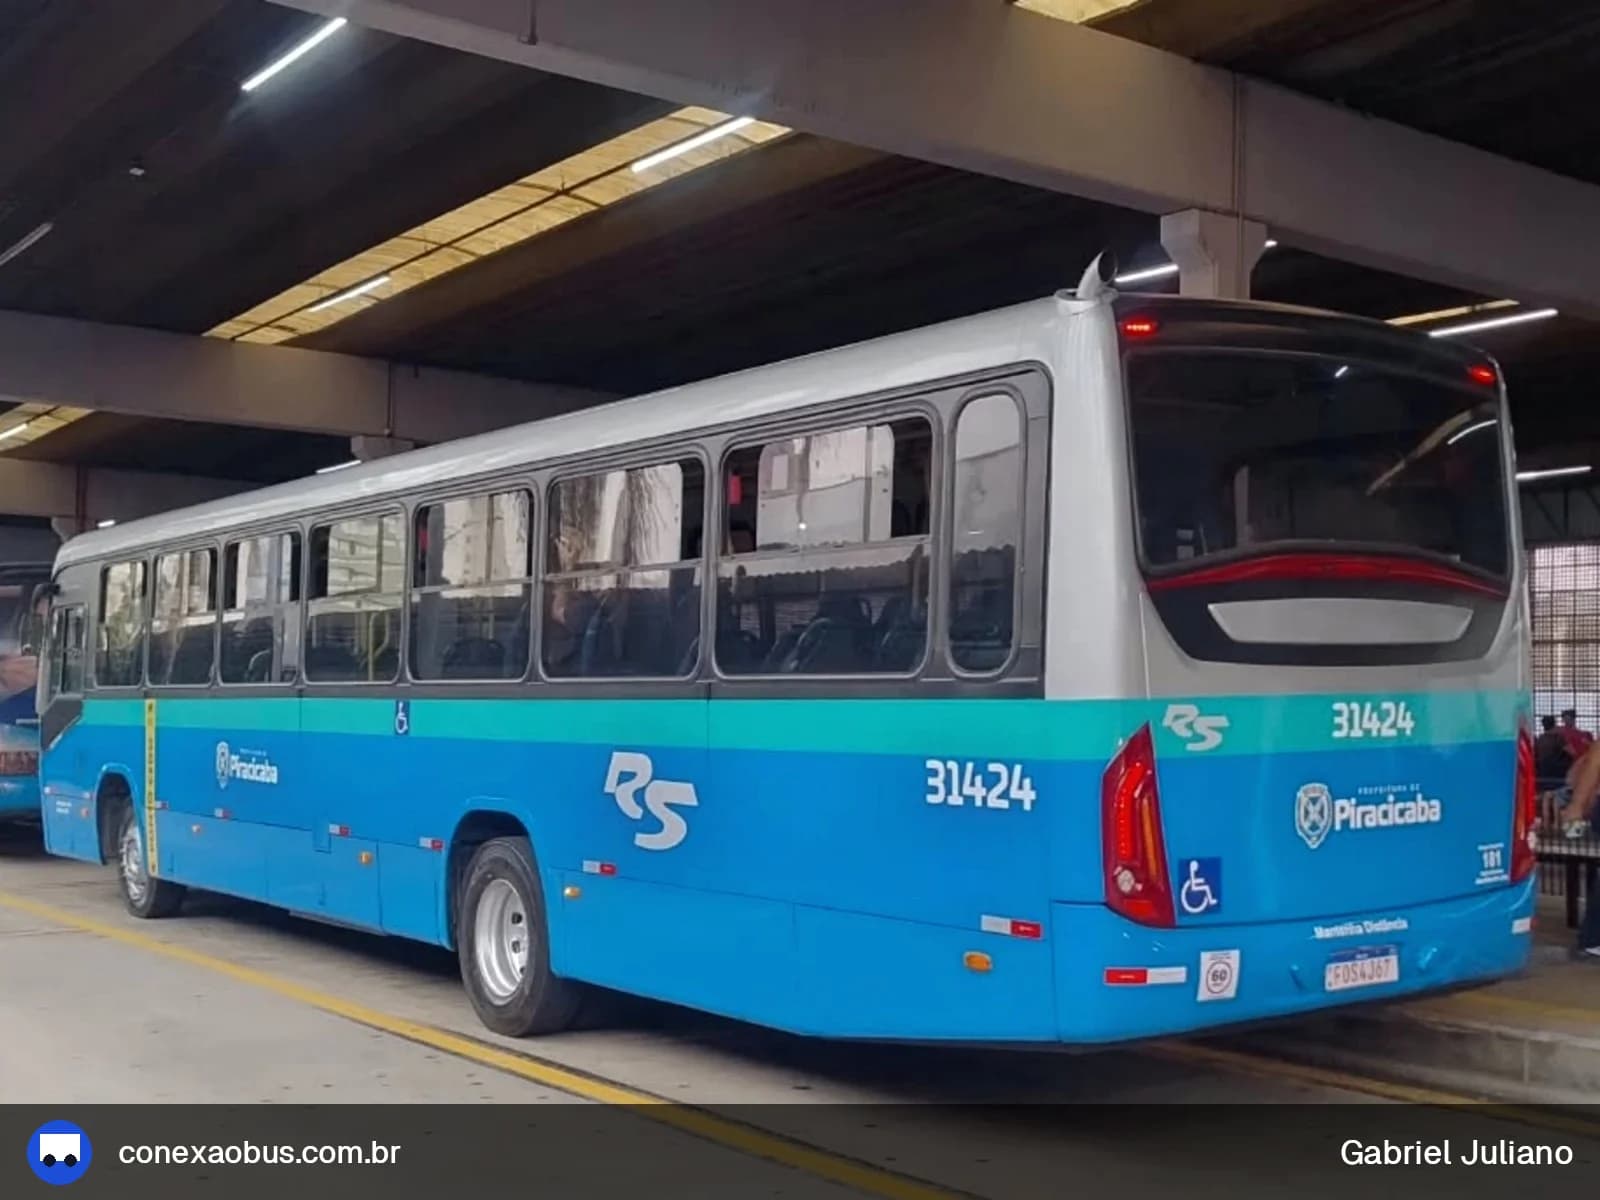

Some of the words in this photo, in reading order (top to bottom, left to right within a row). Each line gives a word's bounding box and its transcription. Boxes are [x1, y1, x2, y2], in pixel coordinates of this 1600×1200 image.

[1162, 704, 1229, 751] RS
[1332, 702, 1415, 738] 31424
[229, 754, 278, 784] Piracicaba
[925, 759, 1037, 811] 31424
[604, 751, 698, 850] RS
[1335, 793, 1441, 831] Piracicaba
[1211, 969, 1228, 982] 60
